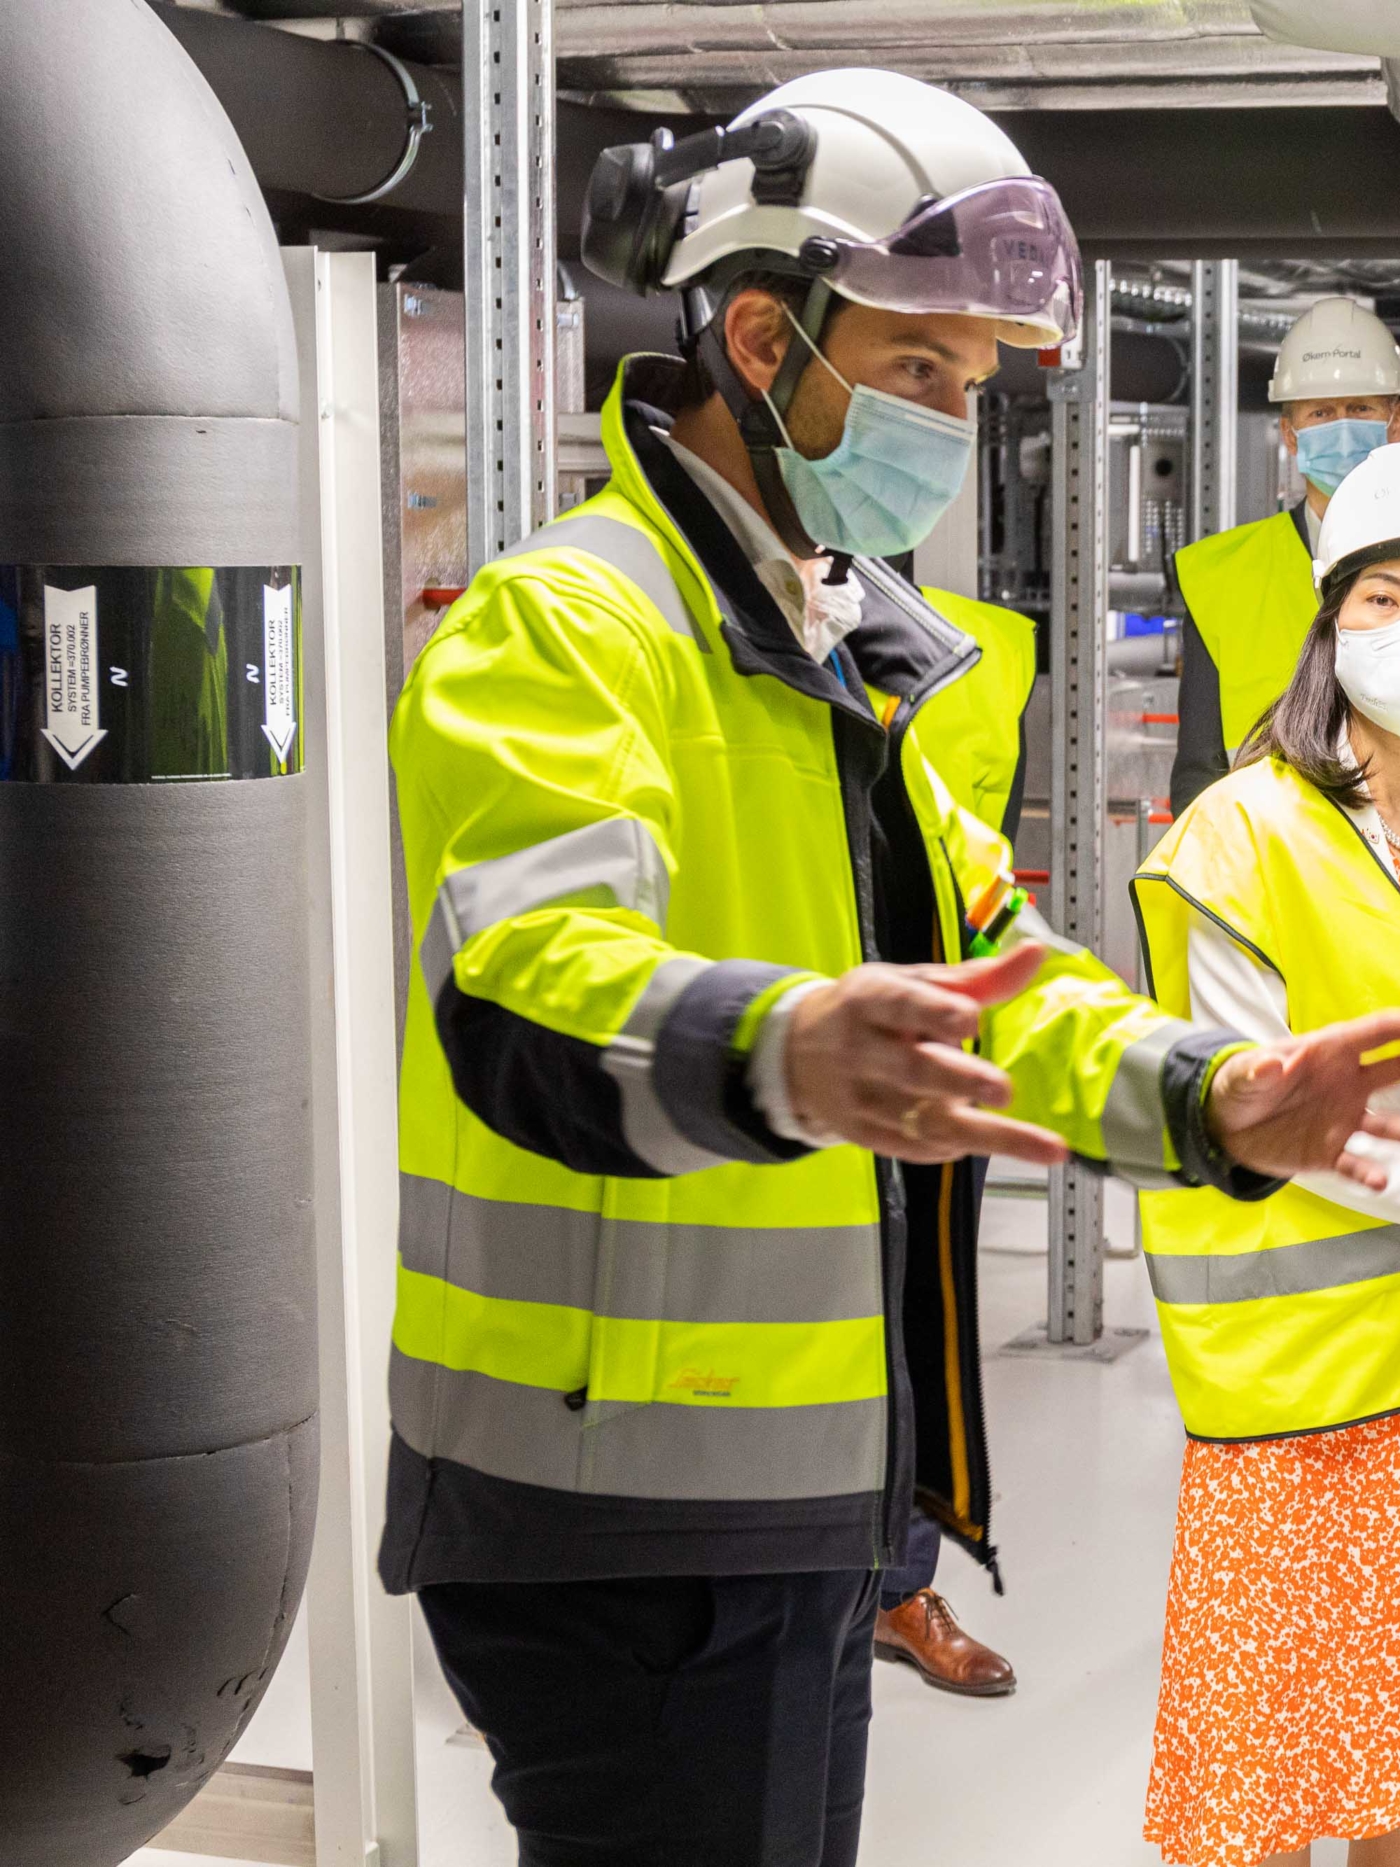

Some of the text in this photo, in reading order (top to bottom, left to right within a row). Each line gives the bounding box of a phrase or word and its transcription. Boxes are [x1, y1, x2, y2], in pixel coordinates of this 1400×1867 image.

[1332, 348, 1362, 359] Portal
[50, 623, 63, 713] KOLLEKTOR
[66, 624, 76, 712] SYSTEM =370.002
[79, 611, 91, 726] FRA PUMPEBRØNNER
[268, 619, 277, 705] KOLLEKTOR
